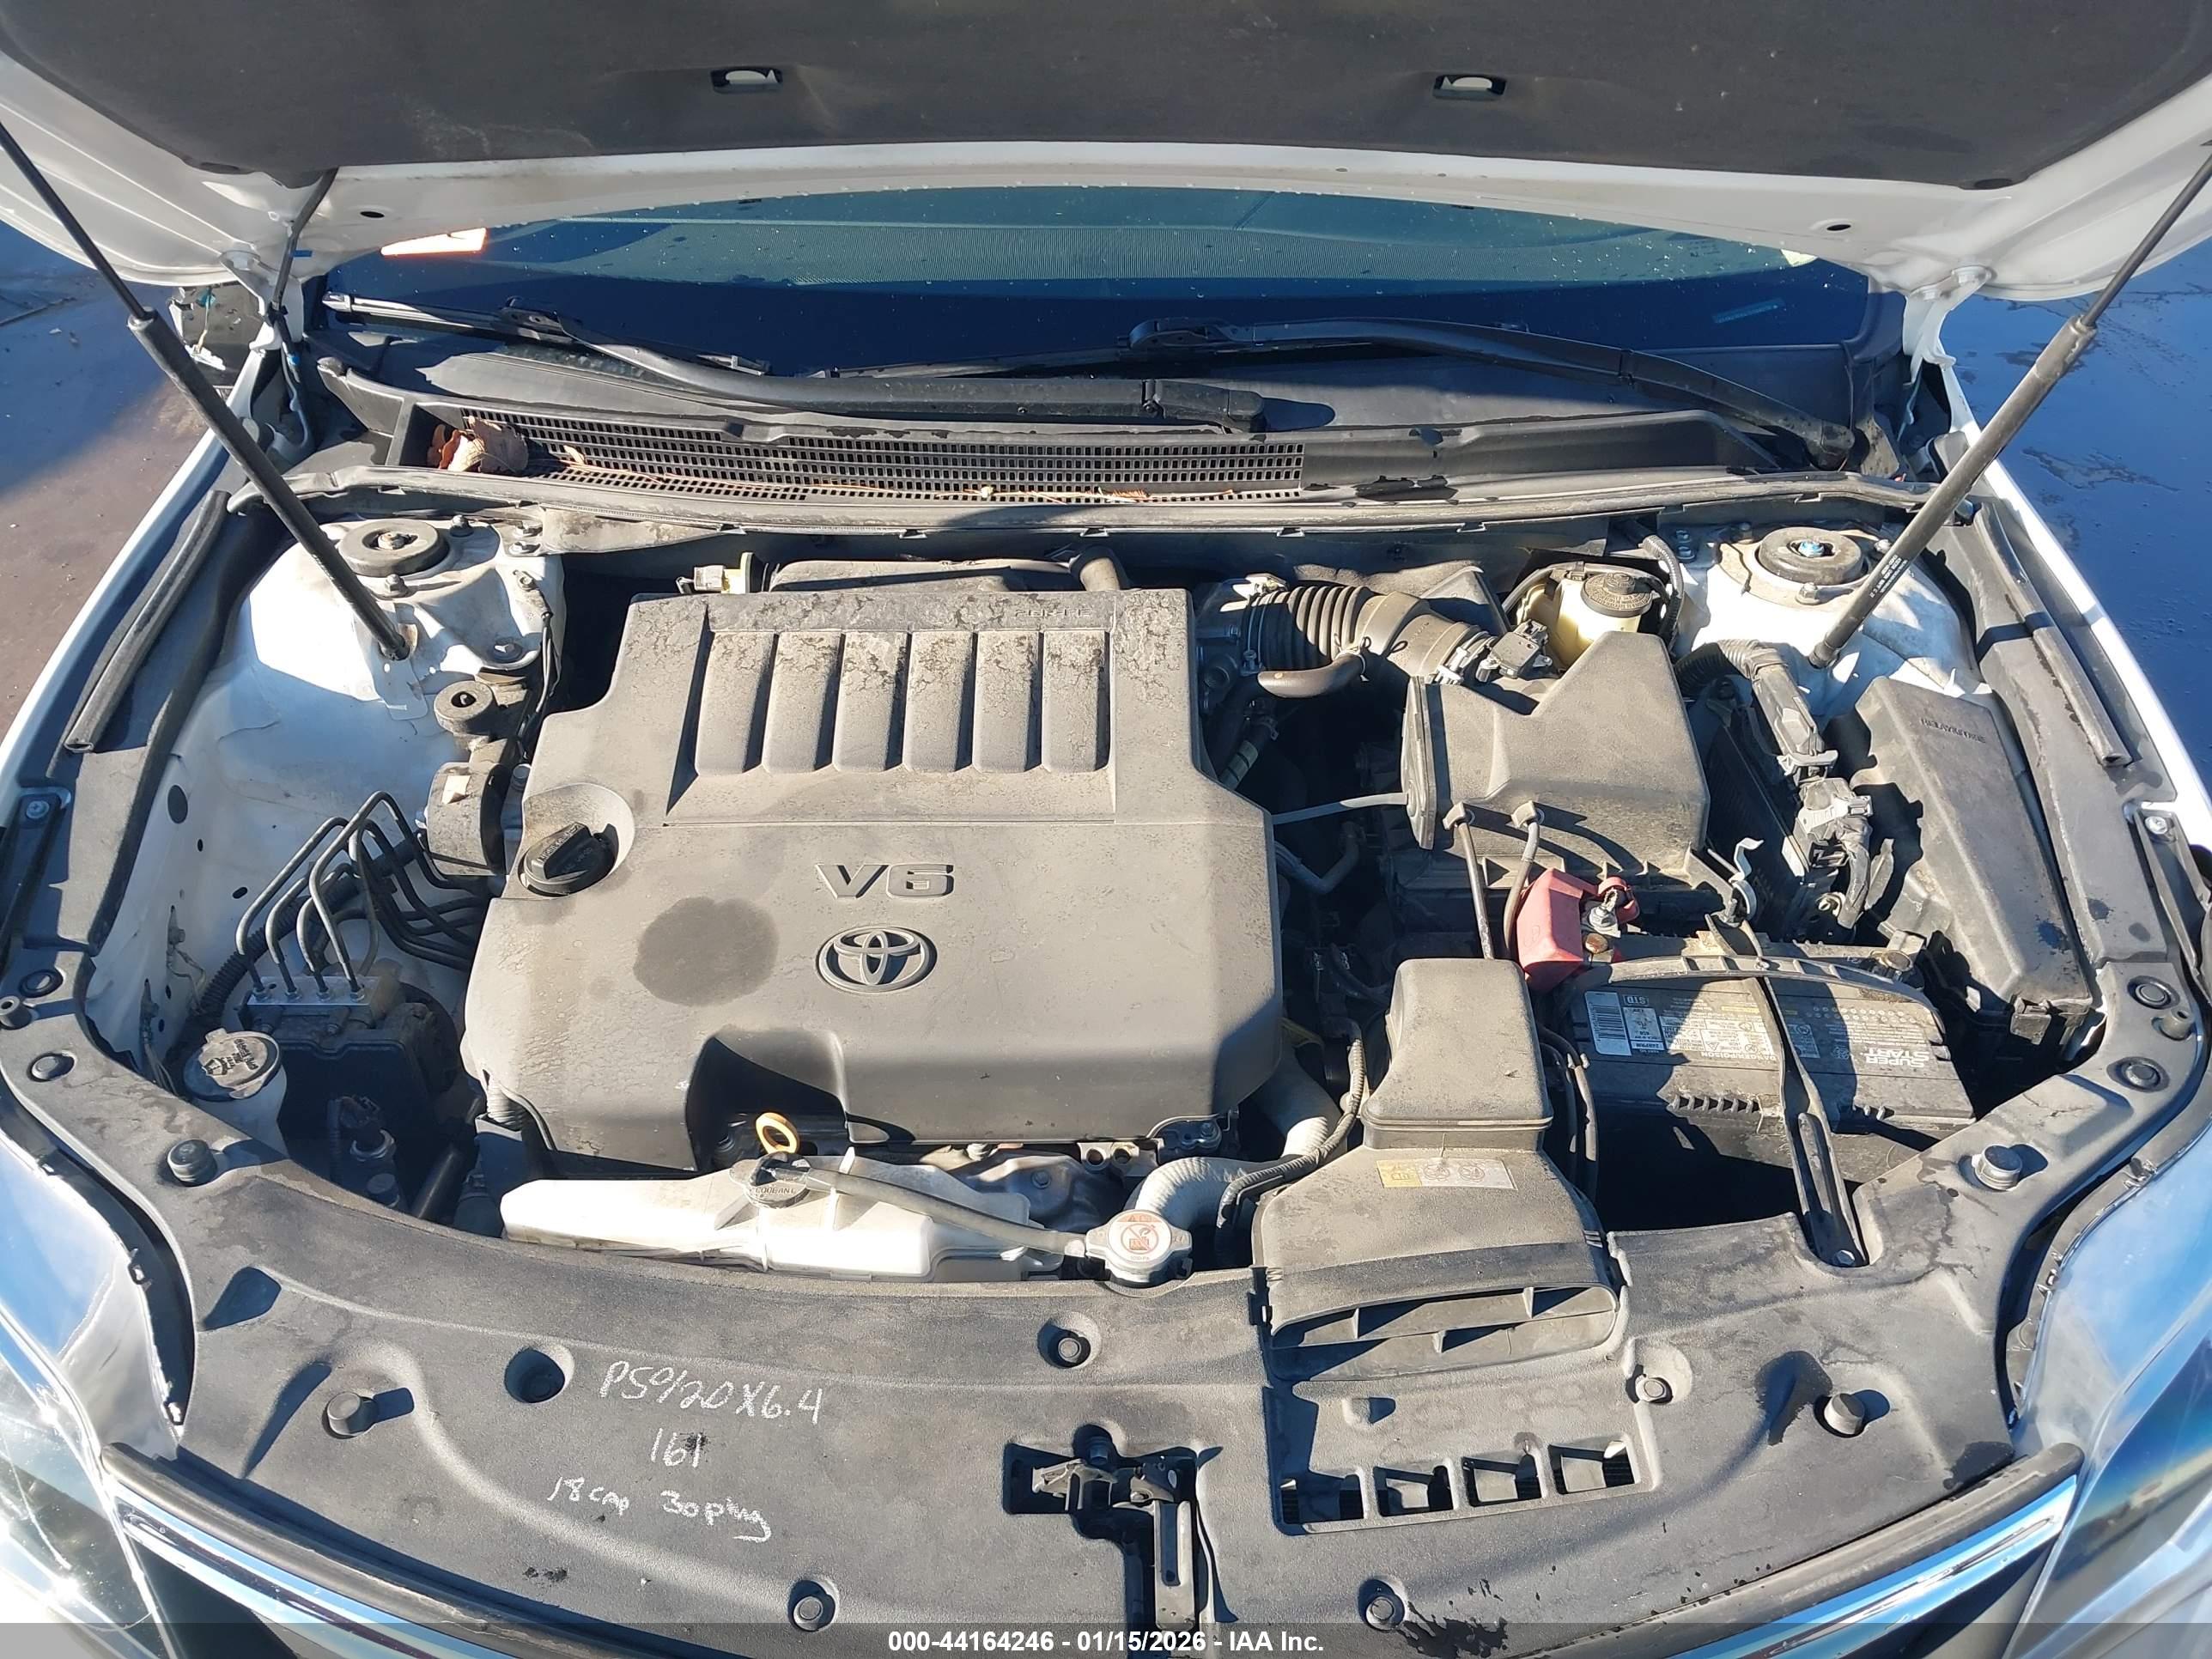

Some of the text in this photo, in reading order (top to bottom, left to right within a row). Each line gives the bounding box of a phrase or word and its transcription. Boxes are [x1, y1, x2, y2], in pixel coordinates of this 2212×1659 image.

[817, 864, 954, 899] V6
[1863, 1048, 1929, 1061] START
[1866, 1055, 1924, 1067] SUPER
